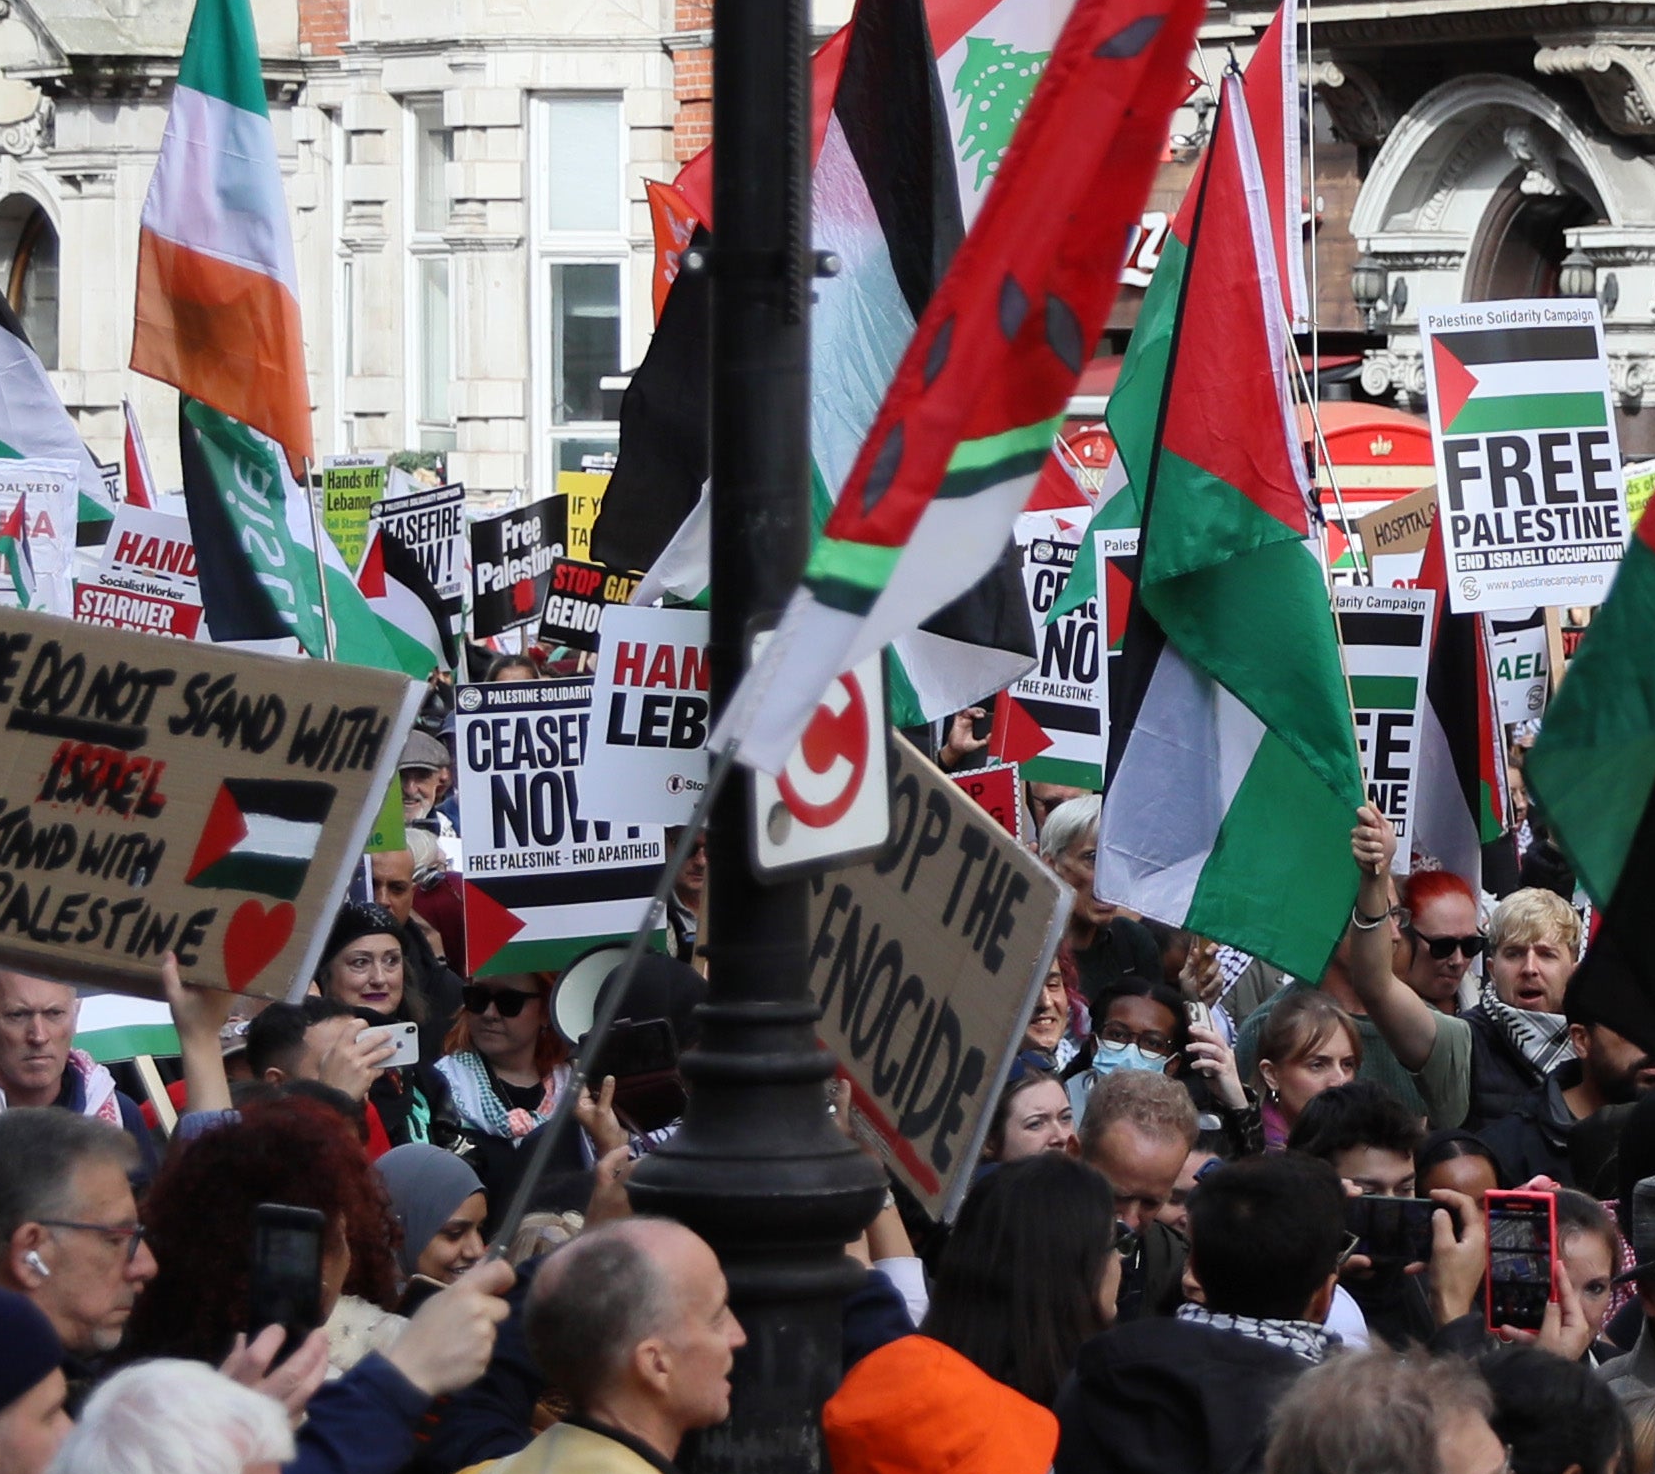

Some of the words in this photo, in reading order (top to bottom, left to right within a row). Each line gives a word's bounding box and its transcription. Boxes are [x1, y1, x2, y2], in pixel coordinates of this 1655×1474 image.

[1428, 311, 1484, 328] Palestine
[1487, 309, 1542, 326] Solidarity
[1544, 308, 1595, 324] Campaign
[327, 471, 358, 491] Hands
[360, 469, 380, 489] off
[1442, 430, 1618, 511] FREE
[327, 492, 372, 513] Lebanon
[502, 515, 542, 554] Free
[1451, 504, 1623, 549] PALESTINE
[477, 541, 565, 597] Palestine
[1458, 552, 1486, 572] END
[1488, 547, 1545, 570] ISRAELI
[1547, 542, 1624, 564] OCCUPATION
[99, 573, 145, 593] Socialist
[145, 582, 185, 602] Worker
[552, 563, 602, 597] STOP
[1486, 573, 1604, 591] www.palestinecampaign.org
[78, 590, 175, 630] STARMER
[1366, 595, 1426, 612] Campaign
[18, 638, 86, 716] DO
[86, 659, 177, 725] NOT
[169, 672, 286, 755] STAND
[287, 702, 390, 772] WITH
[487, 687, 540, 706] PALESTINE
[1016, 678, 1040, 695] FREE
[1042, 681, 1093, 701] PALESTINE
[76, 831, 166, 888] WITH
[468, 854, 498, 873] FREE
[500, 850, 562, 871] PALESTINE
[572, 848, 595, 865] END
[597, 841, 661, 863] APARTHEID
[943, 822, 1031, 977] THE
